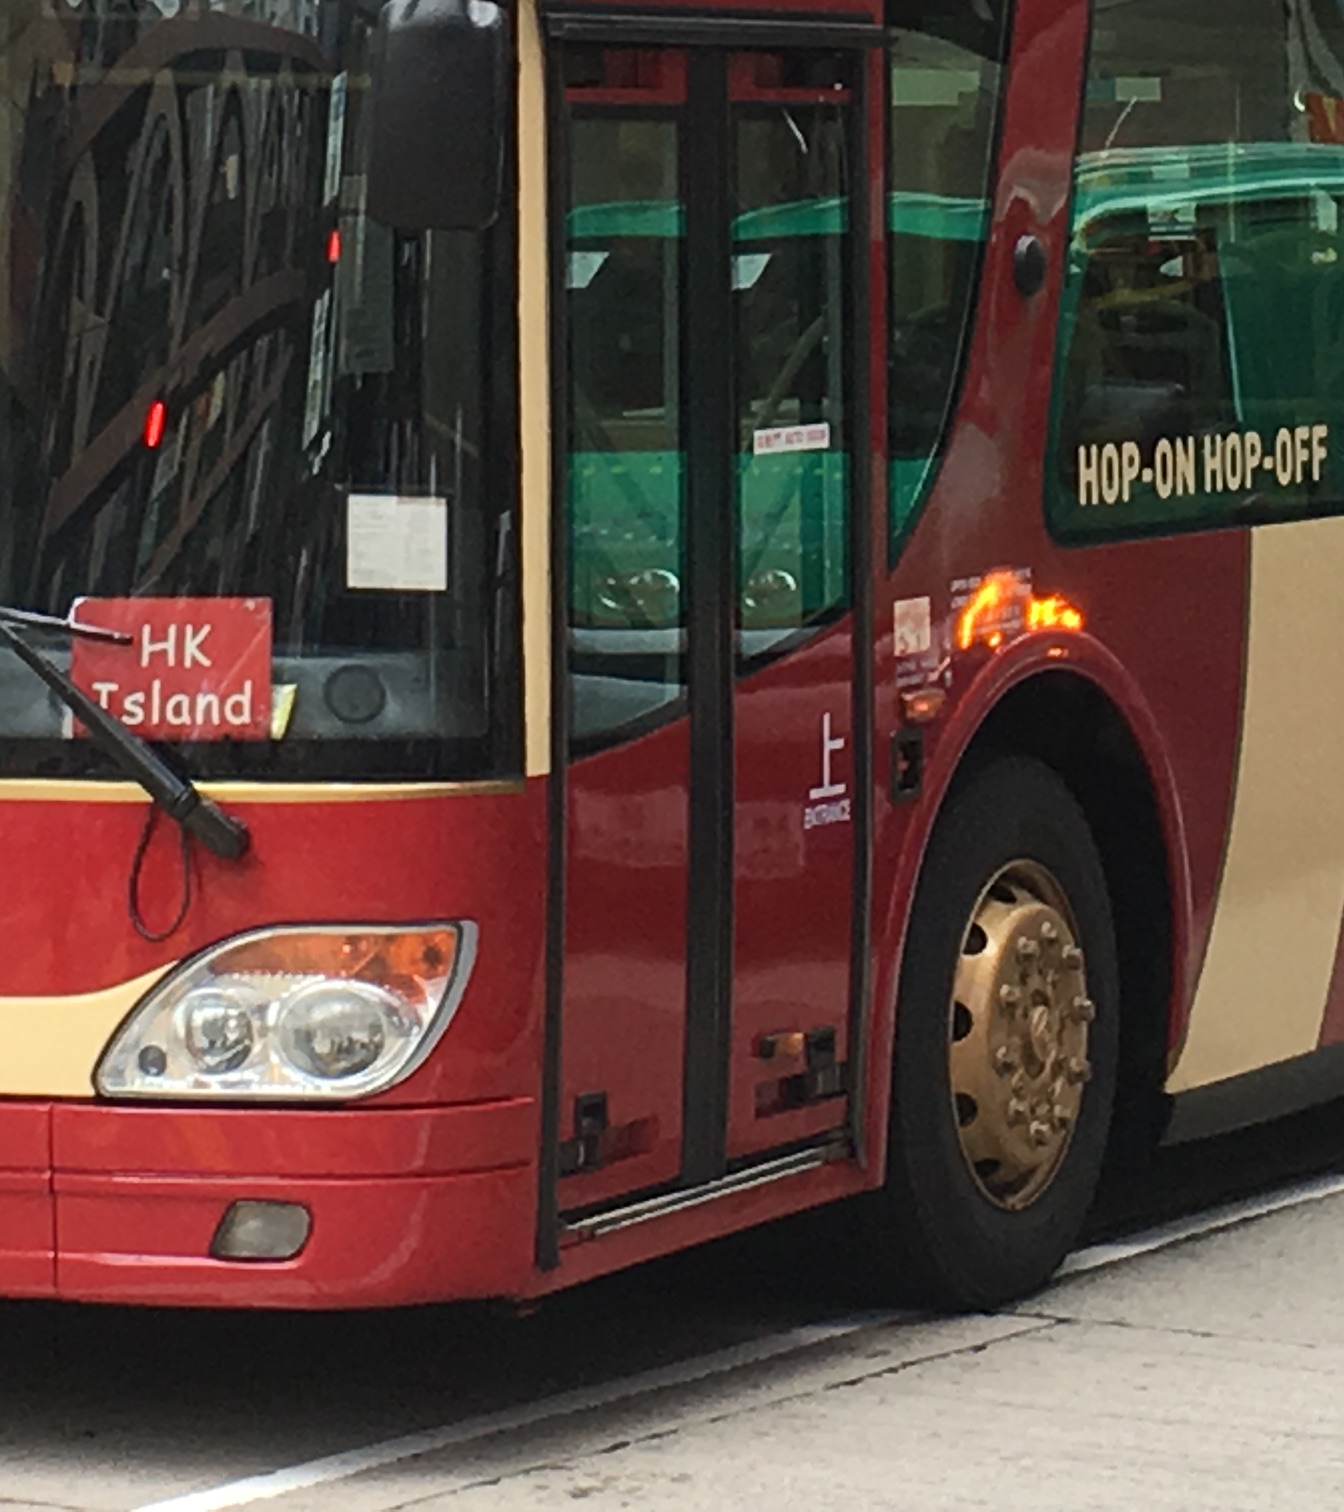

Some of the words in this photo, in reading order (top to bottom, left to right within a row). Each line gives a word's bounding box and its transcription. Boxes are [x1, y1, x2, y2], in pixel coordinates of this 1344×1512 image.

[1078, 435, 1196, 506] HOP-ON
[1203, 424, 1328, 494] HOP-OFF
[140, 623, 212, 668] HK
[91, 678, 253, 726] Island
[809, 711, 847, 800] 上
